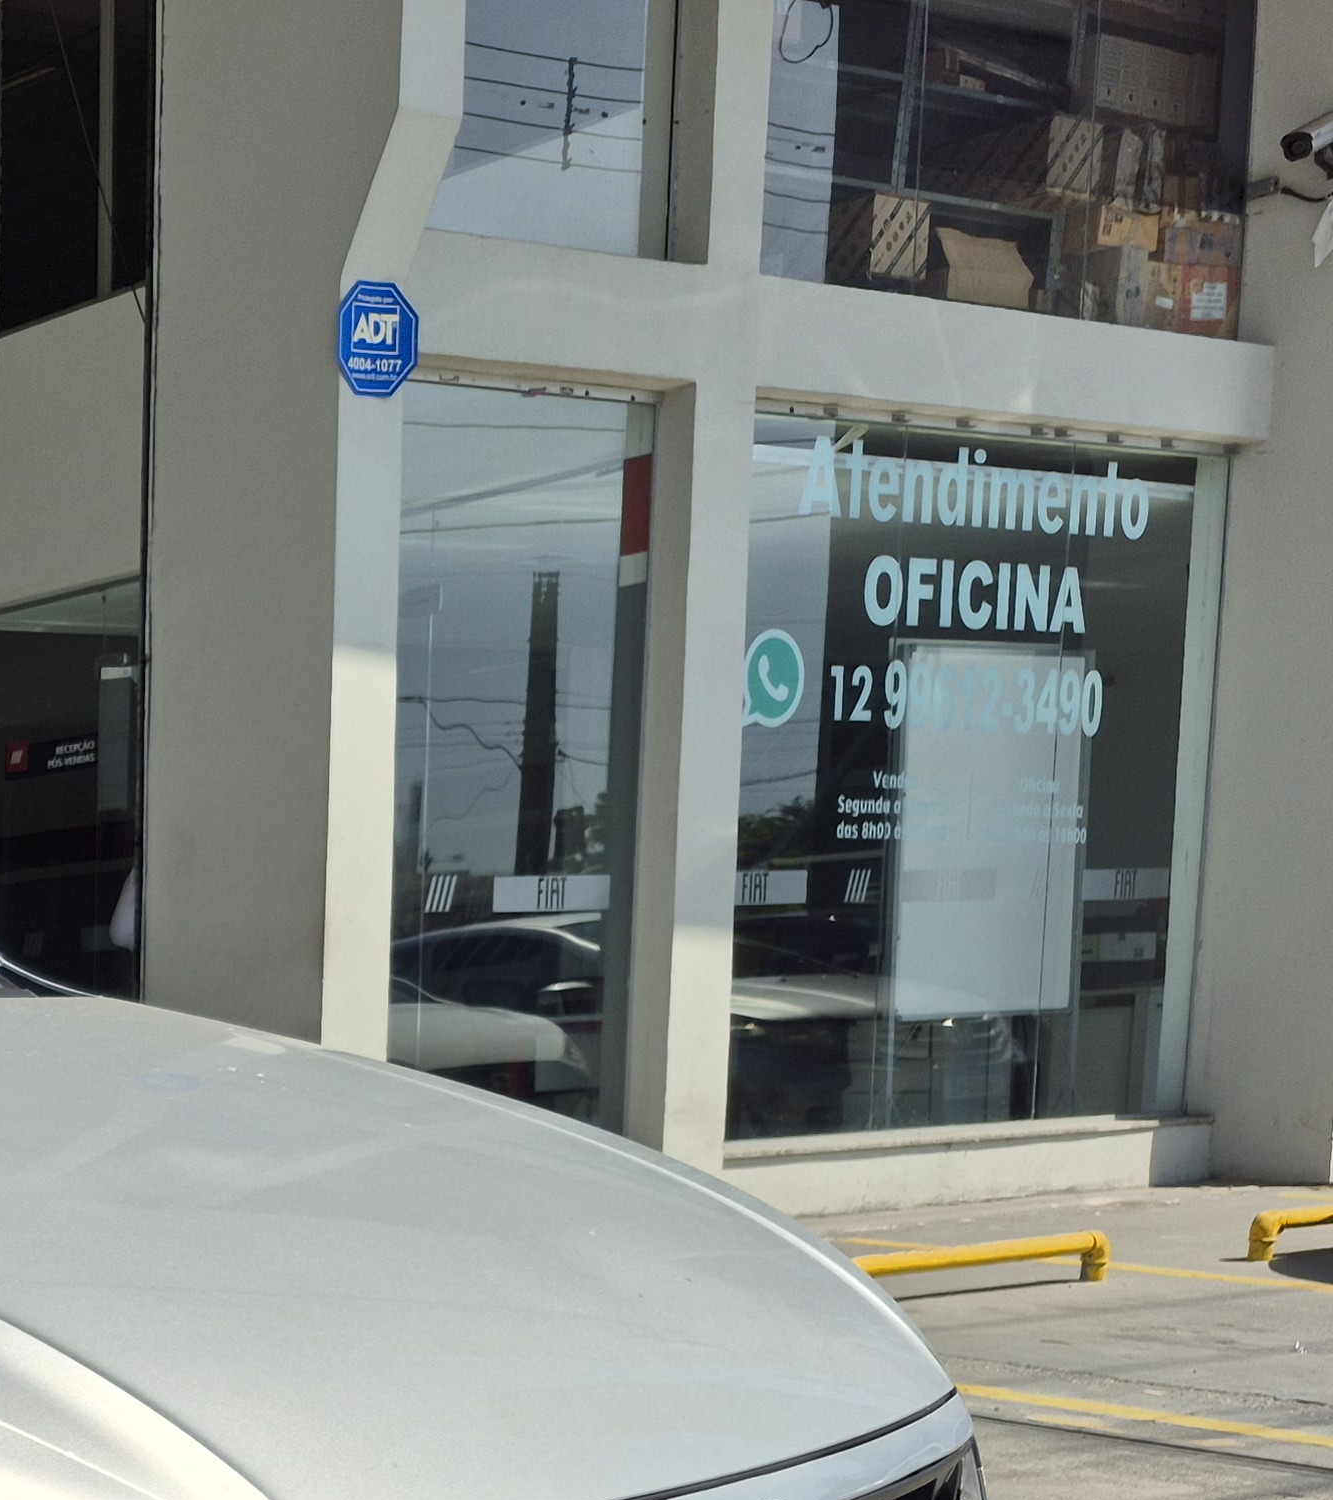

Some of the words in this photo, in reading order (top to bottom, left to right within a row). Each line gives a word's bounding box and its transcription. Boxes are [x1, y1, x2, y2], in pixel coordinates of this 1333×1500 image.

[353, 312, 399, 345] ADT
[347, 356, 403, 373] 4004-1077
[798, 435, 1150, 540] Atendimento
[863, 554, 1086, 634] OFICINA
[830, 664, 874, 722] 12
[883, 659, 1103, 737] 99612-3490
[873, 769, 916, 790] Vend
[837, 794, 891, 818] Segunda
[836, 819, 858, 840] das
[861, 820, 892, 840] 8h00
[537, 877, 567, 909] FIAT
[741, 872, 769, 902] FIAT
[1114, 870, 1139, 898] FIAT
